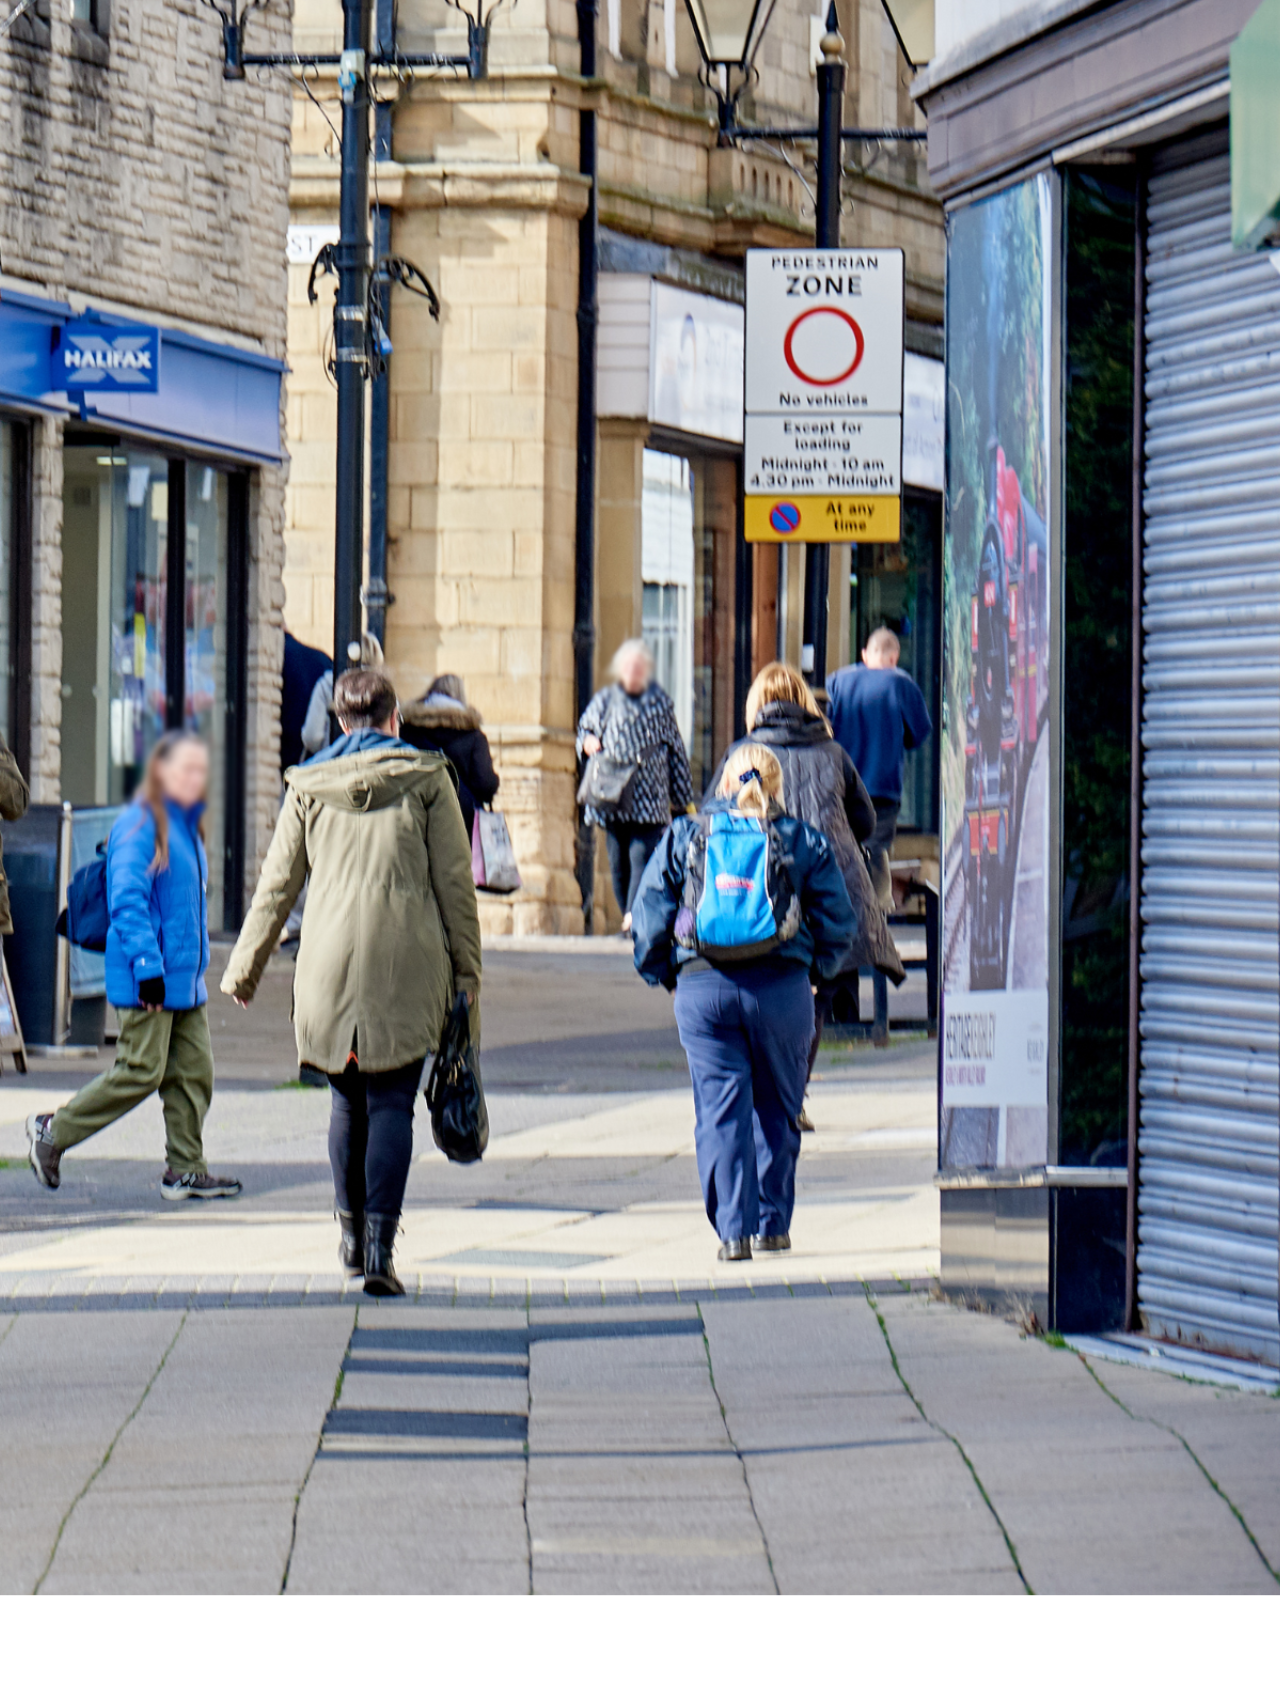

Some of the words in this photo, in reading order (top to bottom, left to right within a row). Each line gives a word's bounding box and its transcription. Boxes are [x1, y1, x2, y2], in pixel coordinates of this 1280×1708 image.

[771, 255, 879, 270] PEDESTRIAN
[786, 274, 862, 297] ZONE
[65, 349, 152, 370] HALIFAX
[779, 390, 801, 407] No
[805, 390, 869, 407] vehicles
[783, 420, 835, 436] Except
[842, 420, 863, 435] for
[795, 437, 851, 453] loading
[761, 456, 828, 473] Midnight
[842, 457, 859, 471] 10
[863, 459, 884, 471] am
[751, 473, 788, 488] 4.30
[791, 474, 814, 490] pm
[827, 473, 894, 490] Midnight
[826, 501, 843, 516] At
[849, 503, 875, 518] any
[834, 518, 866, 533] time
